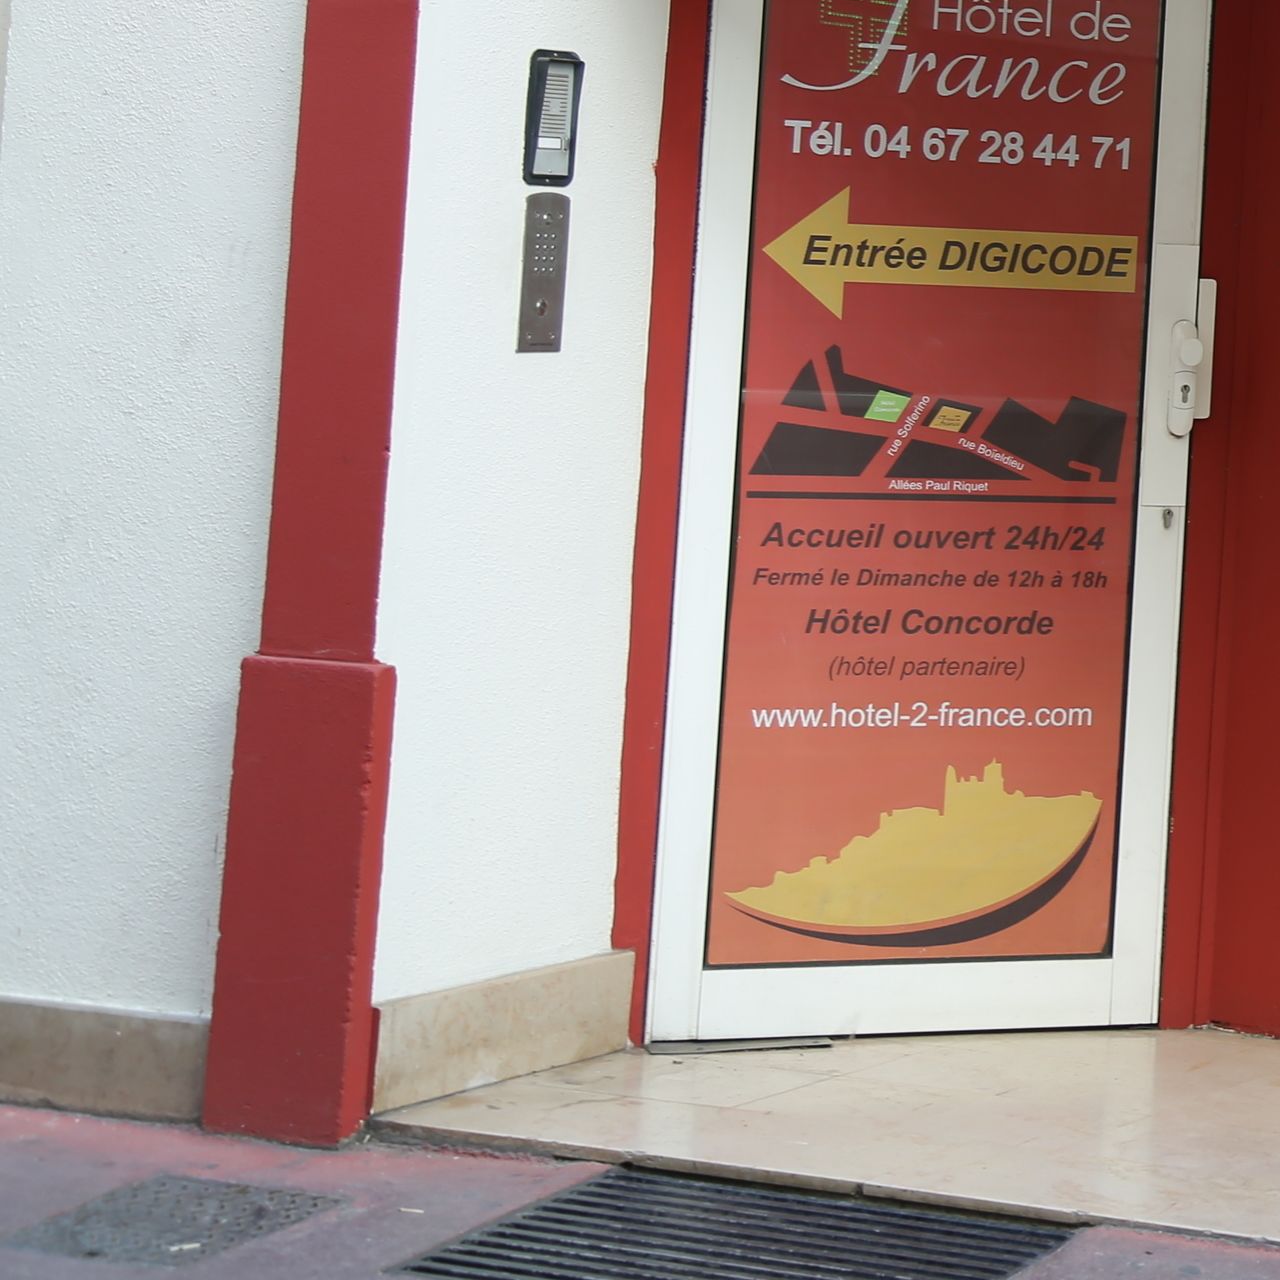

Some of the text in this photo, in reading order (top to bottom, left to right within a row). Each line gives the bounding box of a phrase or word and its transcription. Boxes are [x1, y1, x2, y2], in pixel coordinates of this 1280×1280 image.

[1069, 0, 1133, 44] de
[784, 119, 1132, 171] Tél. 04 67 28 44 71
[803, 234, 1134, 279] Entrée DIGICODE
[886, 438, 903, 456] rue
[958, 437, 977, 450] rue
[888, 479, 989, 493] Allées Paul Riquet
[759, 521, 1106, 552] Accueil ouvert 24h/24
[752, 567, 1109, 590] Fermé le Dimanche de 12h à 18h
[804, 607, 1055, 636] Hôtel Concorde
[828, 655, 1026, 681] (hôtel partenaire)
[751, 701, 1094, 729] www.hotel-2-france.com
